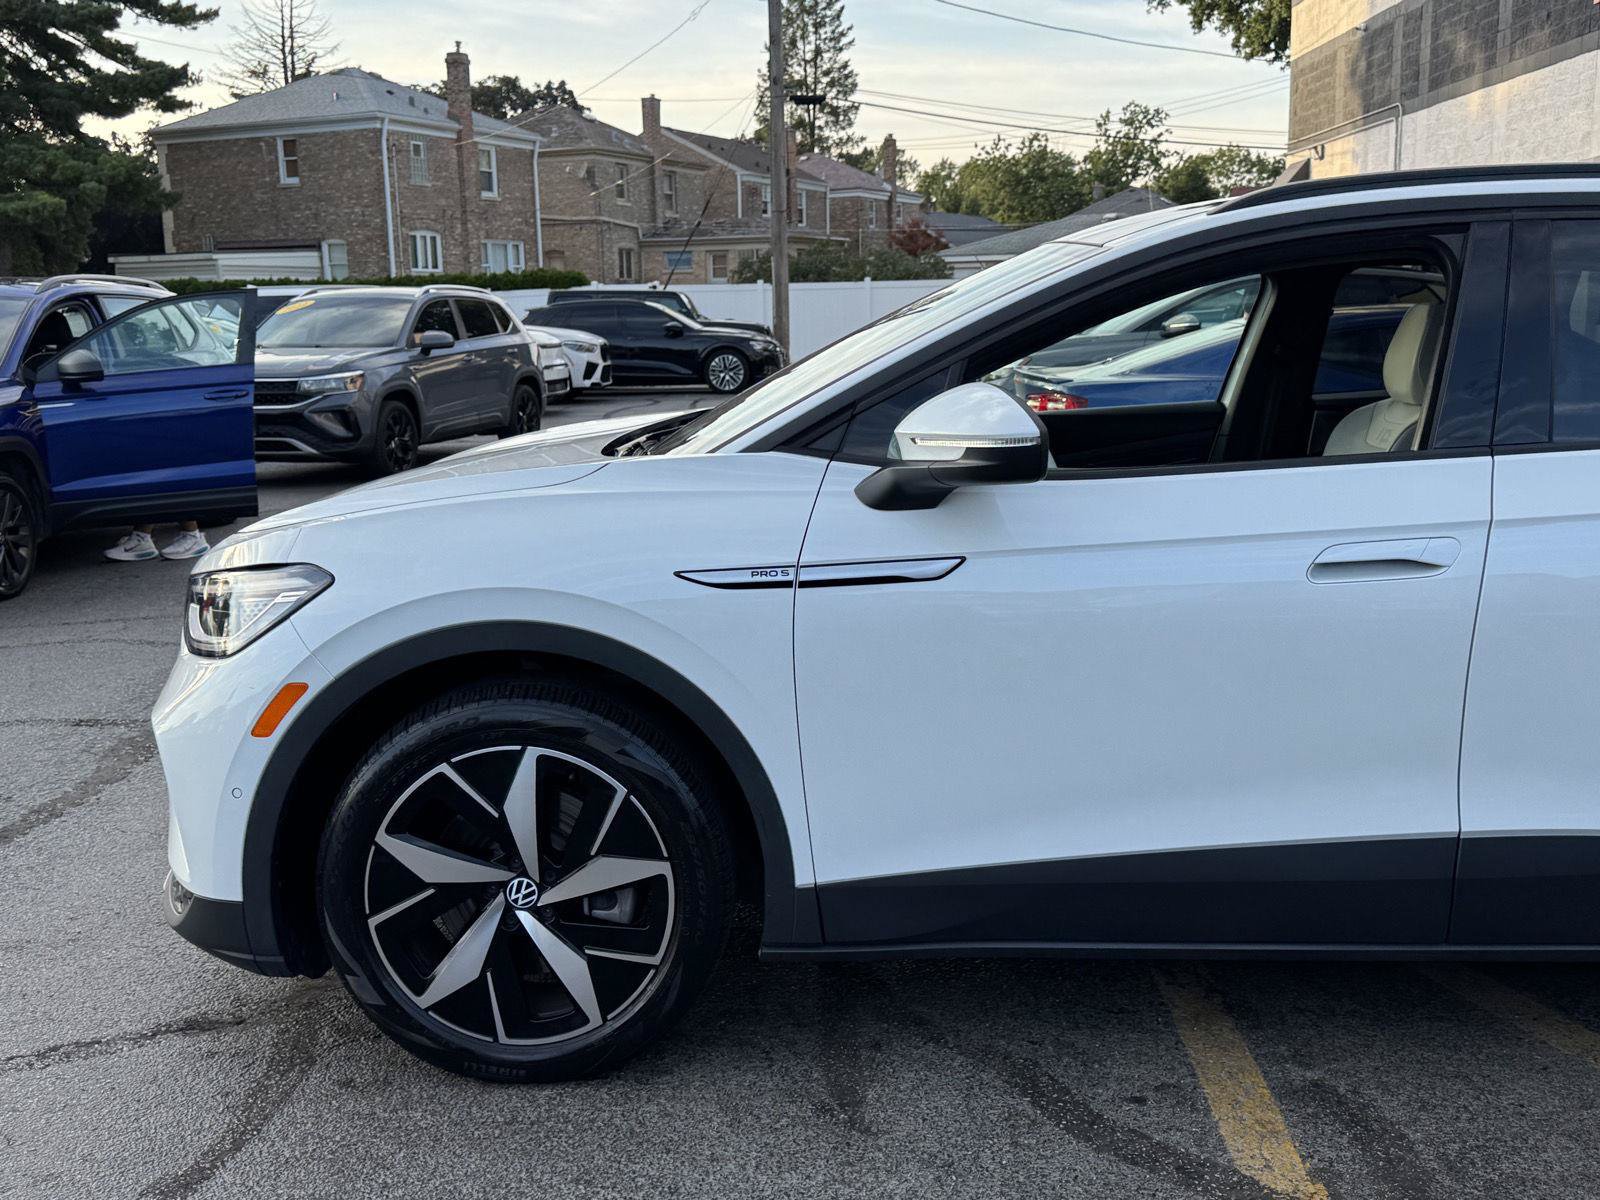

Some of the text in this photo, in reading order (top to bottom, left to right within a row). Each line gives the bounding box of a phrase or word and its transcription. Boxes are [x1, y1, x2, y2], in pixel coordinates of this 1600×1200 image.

[751, 569, 789, 578] PRO S
[506, 878, 538, 908] VW
